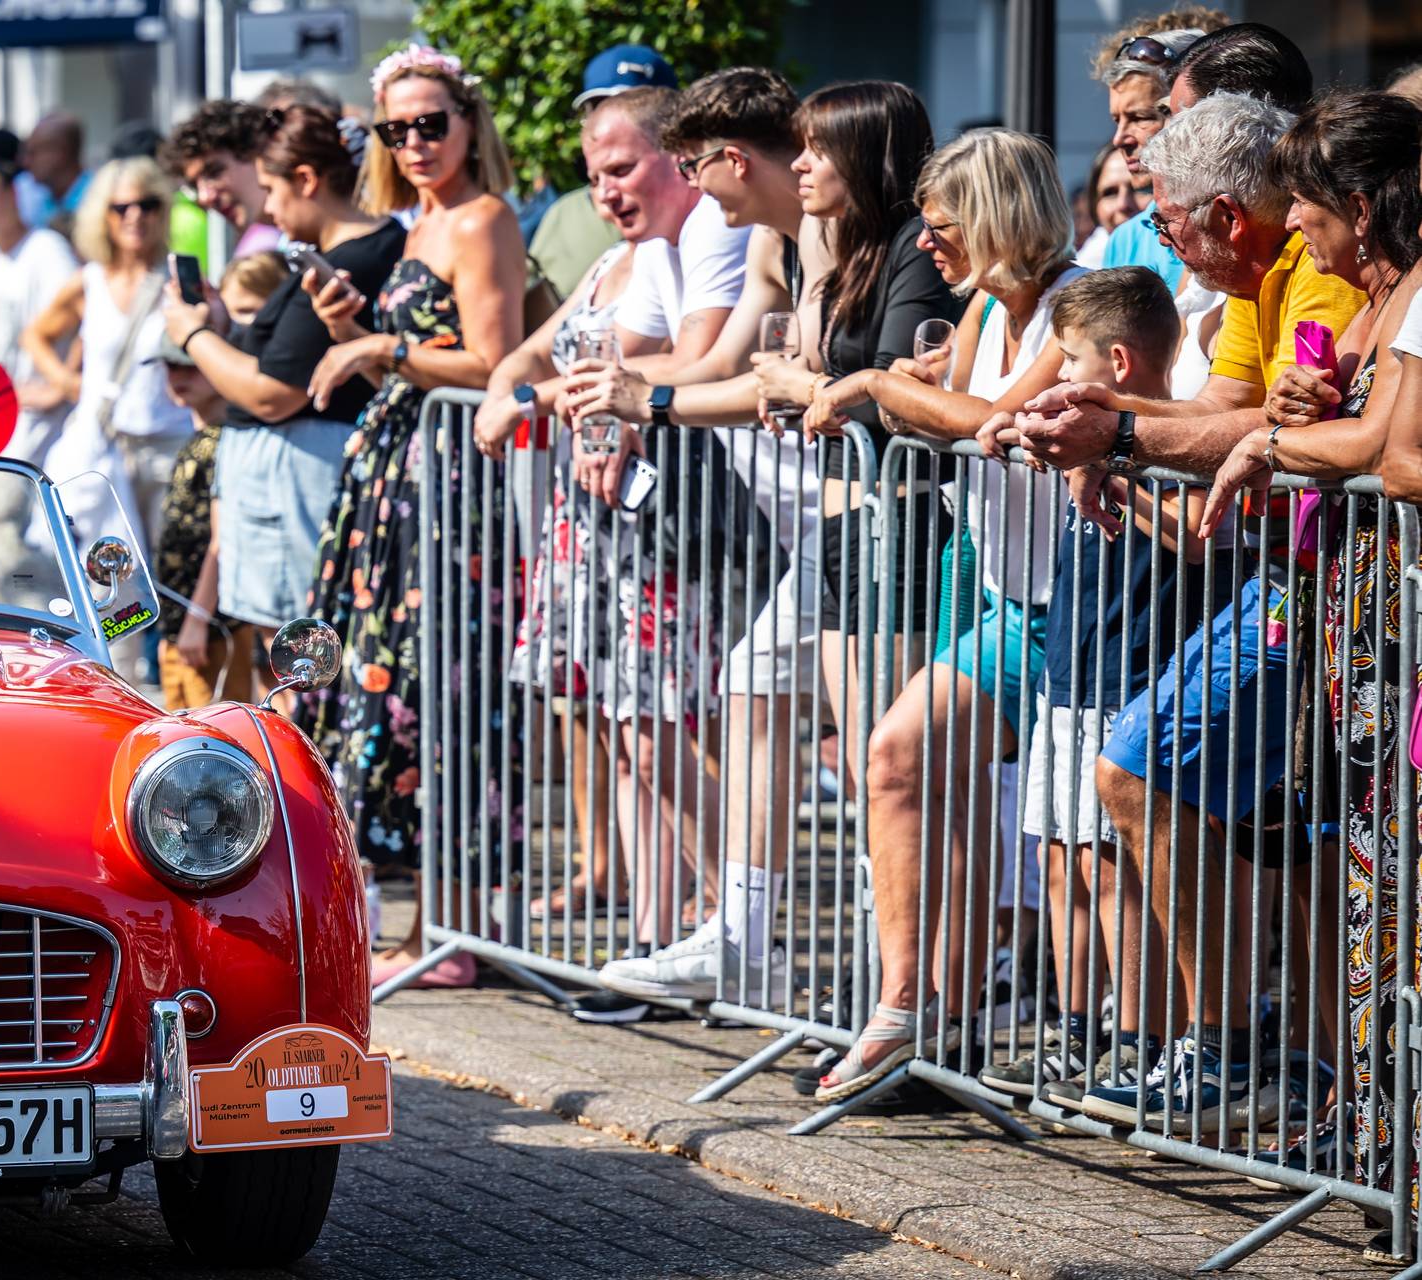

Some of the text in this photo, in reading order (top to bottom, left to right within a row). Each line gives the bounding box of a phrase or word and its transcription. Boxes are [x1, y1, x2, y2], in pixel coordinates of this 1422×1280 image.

[295, 1049, 326, 1063] SAARNER
[244, 1050, 360, 1088] 20 OLDTIMER CUP 24
[221, 1102, 260, 1111] Zentrum
[300, 1092, 316, 1117] 9
